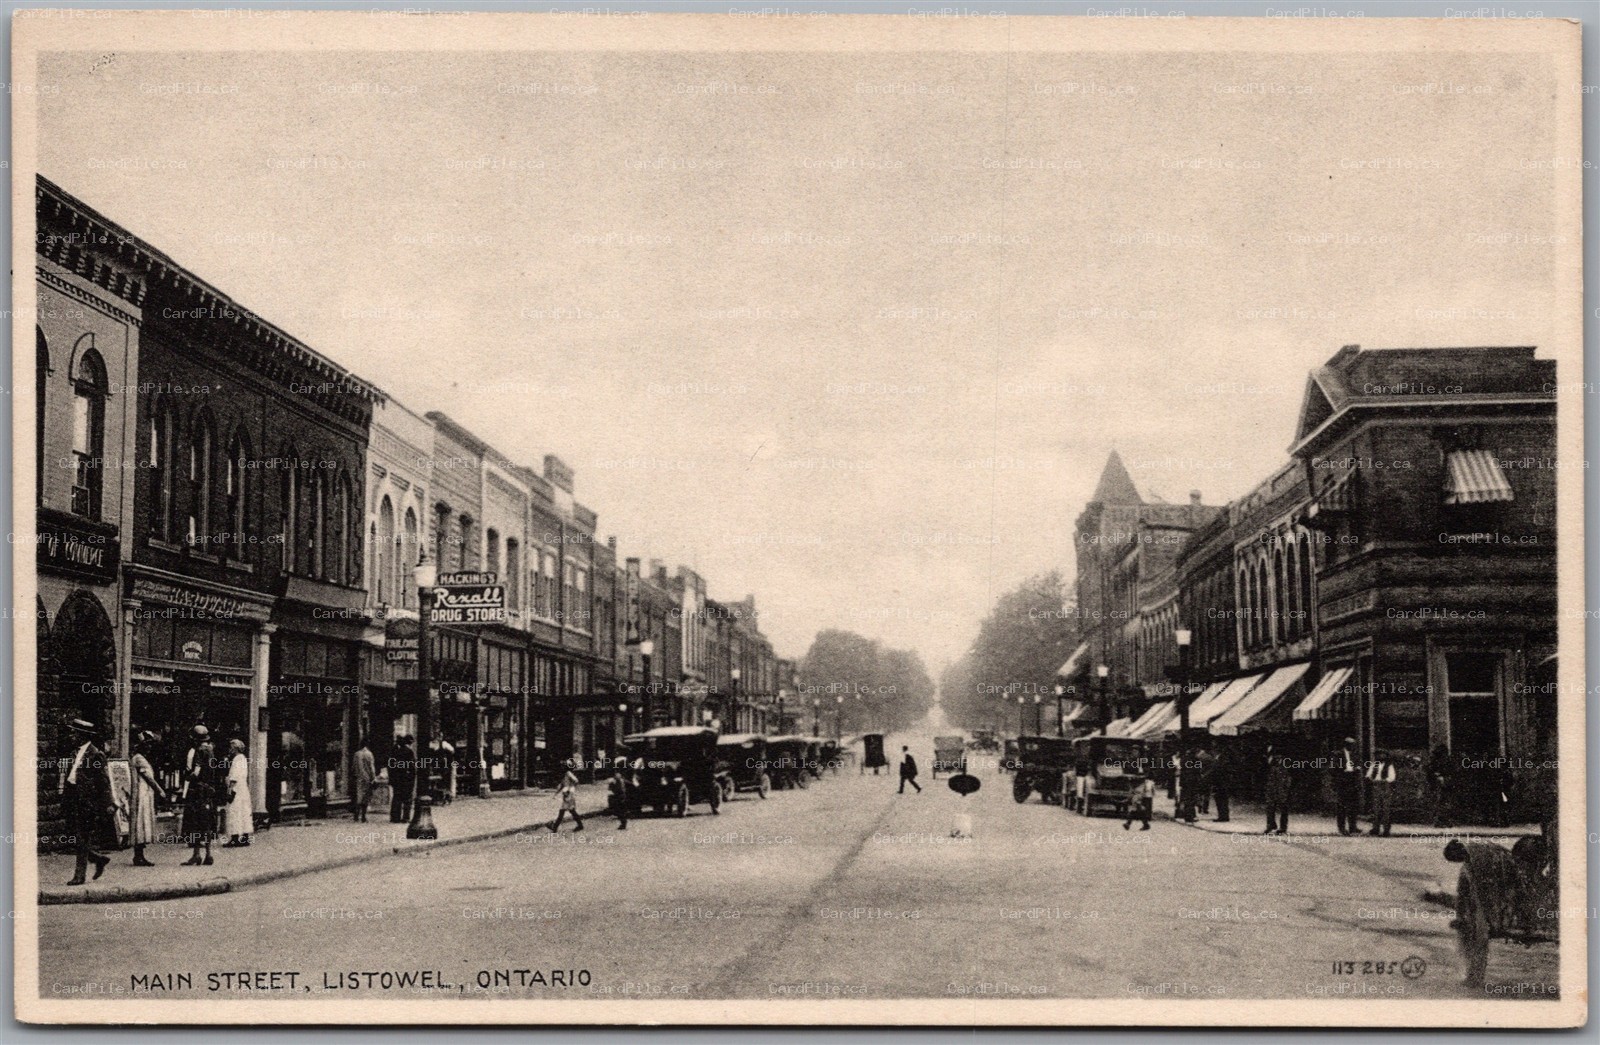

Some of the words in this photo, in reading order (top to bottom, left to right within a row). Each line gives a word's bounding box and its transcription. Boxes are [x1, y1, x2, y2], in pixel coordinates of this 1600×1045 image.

[433, 587, 502, 608] Rexall
[431, 609, 462, 622] DRUG
[466, 608, 506, 622] STORE
